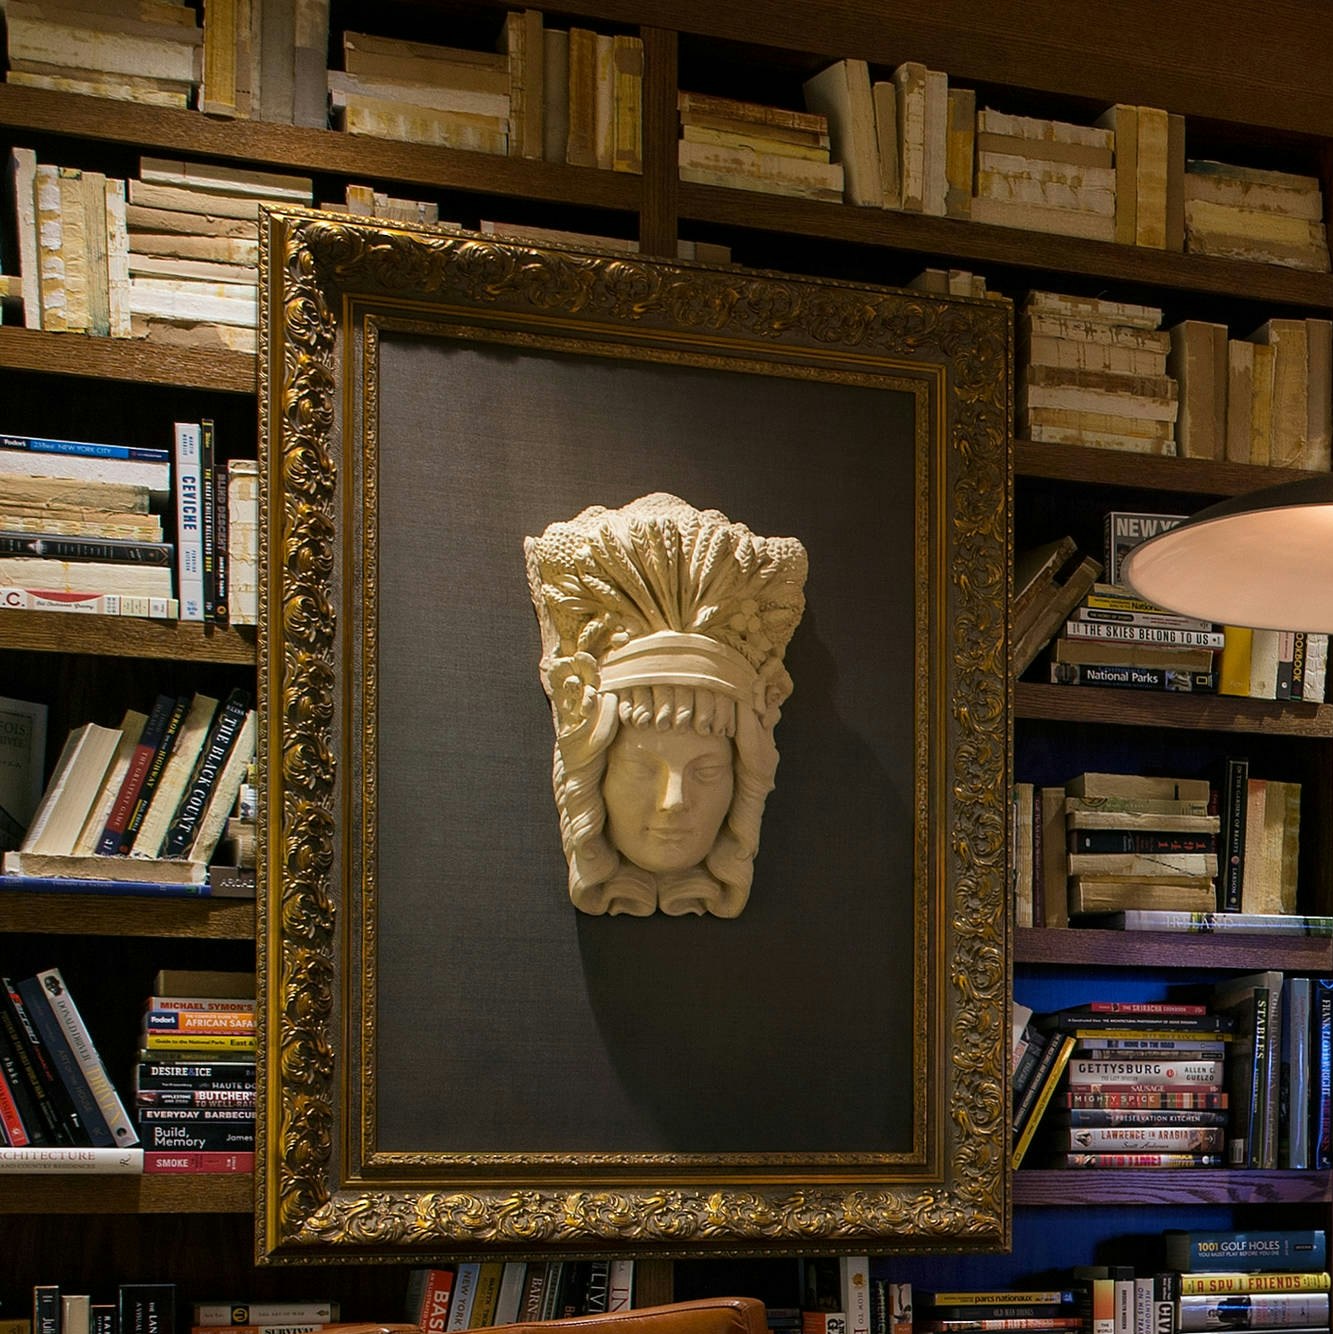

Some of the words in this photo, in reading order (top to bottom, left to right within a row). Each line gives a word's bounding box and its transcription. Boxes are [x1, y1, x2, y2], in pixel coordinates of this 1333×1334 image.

[217, 473, 226, 504] BLIND
[181, 476, 197, 530] CEVICHE
[216, 506, 225, 551] DESCENT
[1084, 623, 1103, 634] THE
[1106, 626, 1134, 638] SKIES
[1139, 628, 1174, 641] BELONG
[1180, 630, 1191, 643] TO
[1196, 631, 1208, 644] US
[1087, 669, 1128, 681] National
[1131, 673, 1157, 683] Parks
[215, 715, 237, 744] THE
[196, 744, 224, 787] BLACK
[178, 787, 206, 833] COUNT
[160, 1001, 204, 1009] MICHAEL
[1255, 1000, 1265, 1058] STABLES
[1079, 1063, 1160, 1073] GETTYSBURG
[85, 1066, 123, 1127] DRIVEN
[154, 1127, 189, 1138] Build,
[154, 1138, 205, 1148] Memory
[156, 1158, 188, 1167] SMOKE
[1198, 1242, 1218, 1250] 1001
[1221, 1242, 1247, 1250] GOLF
[1249, 1241, 1279, 1249] HOLES
[459, 1270, 472, 1295] NEW
[1210, 1279, 1232, 1290] SPY
[1248, 1277, 1300, 1288] FRIENDS
[524, 1277, 545, 1314] BARN
[453, 1297, 467, 1325] YORK
